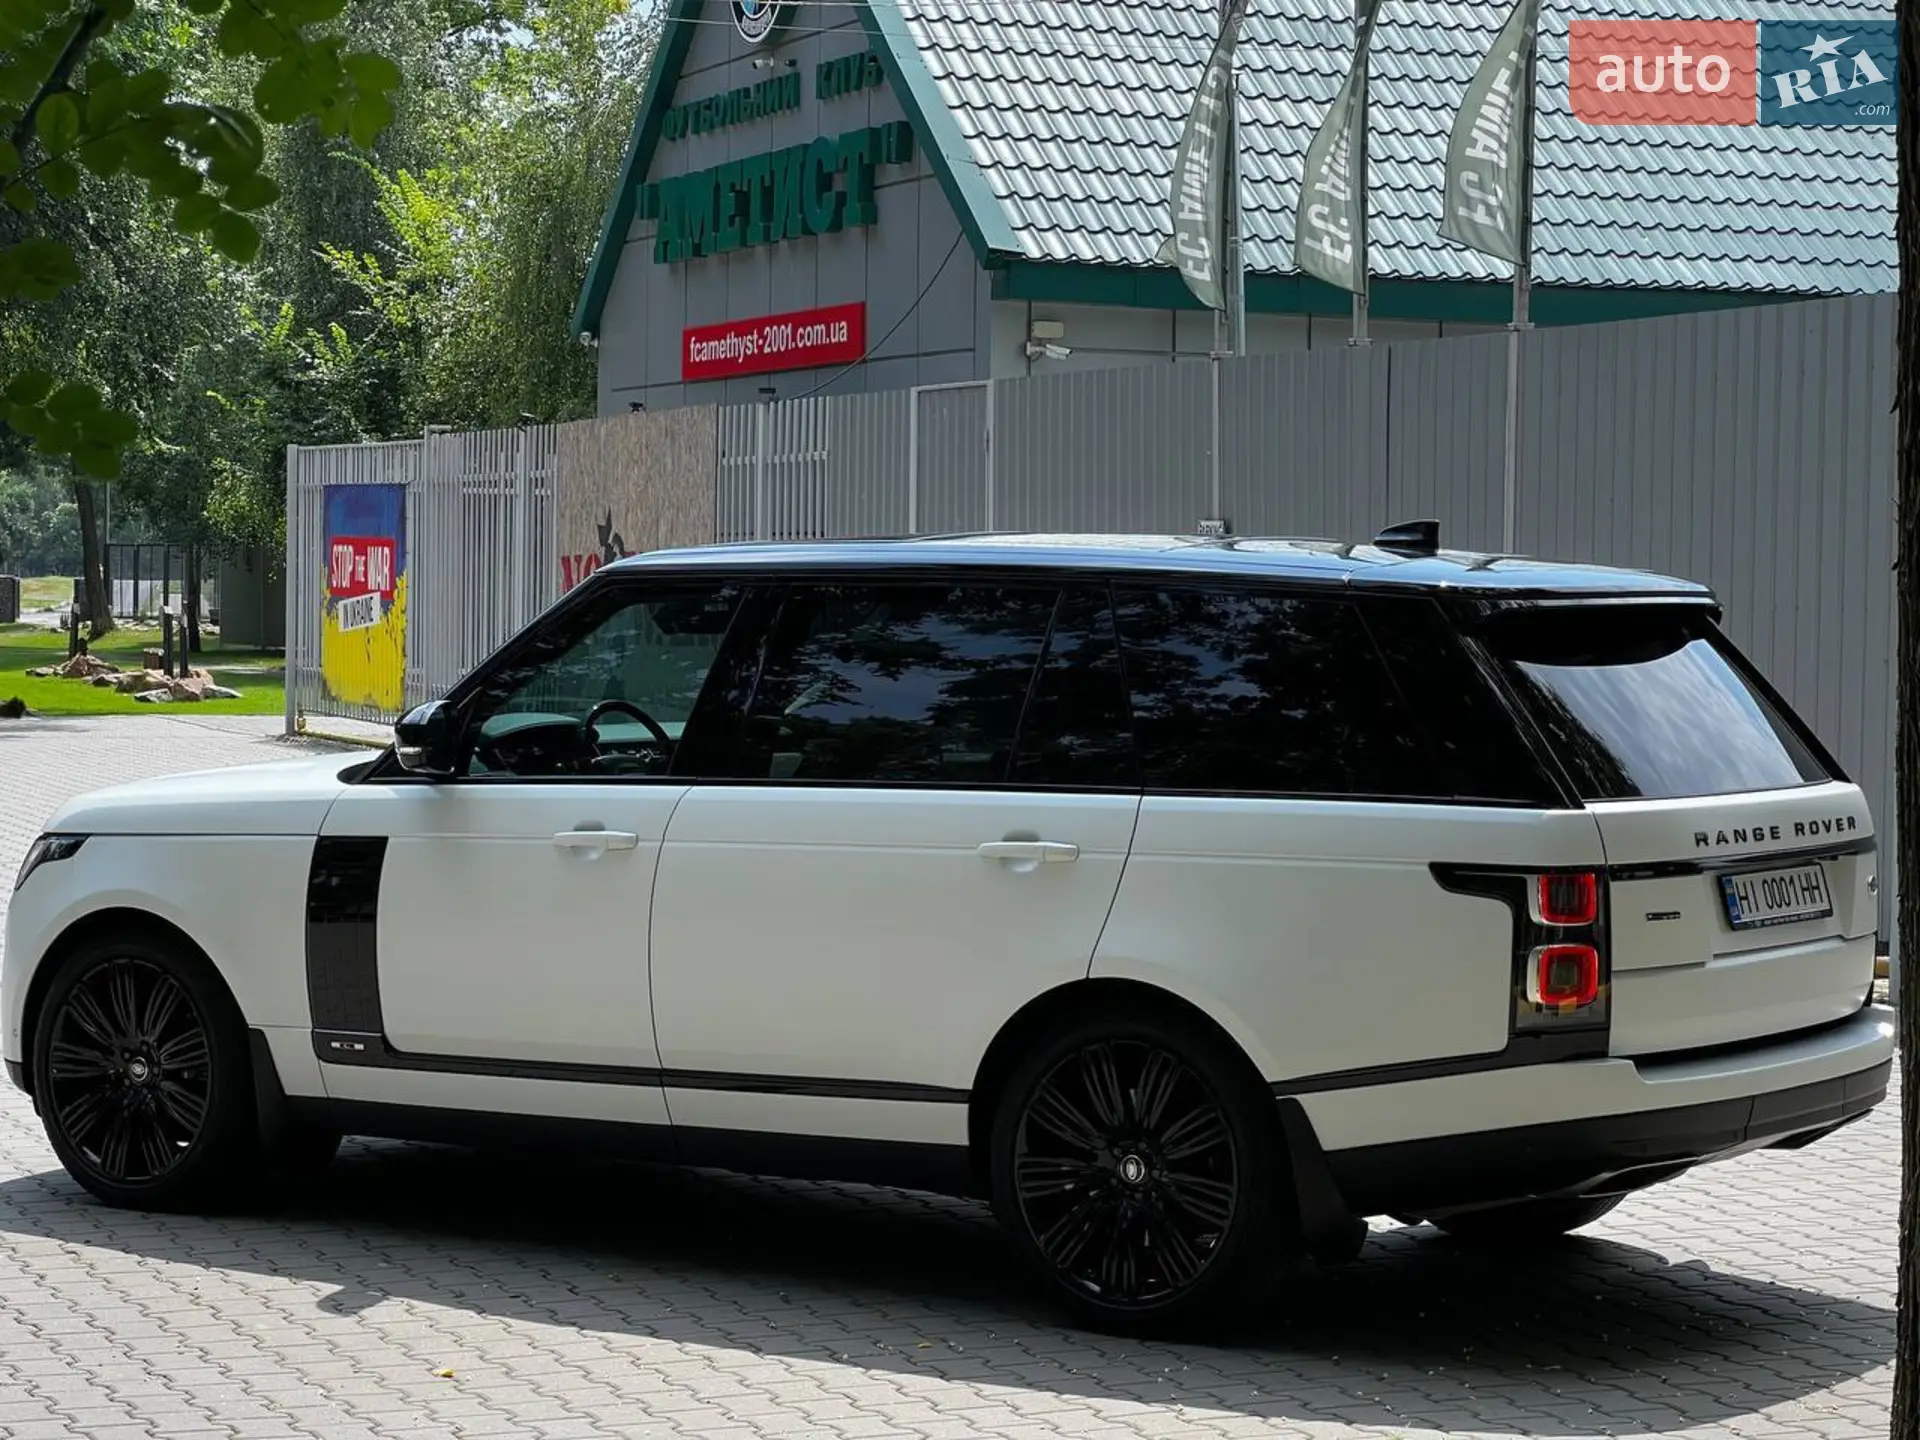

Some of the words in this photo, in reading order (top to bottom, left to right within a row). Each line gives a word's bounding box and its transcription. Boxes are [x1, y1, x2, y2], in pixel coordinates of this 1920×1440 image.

[816, 52, 884, 101] КЛУБ
[690, 310, 848, 363] fcamethyst-2001.com.ua
[332, 543, 354, 588] STOP
[355, 555, 366, 582] THE
[367, 545, 391, 591] WAR
[1694, 826, 1781, 848] RANGE
[1794, 815, 1857, 837] ROVER
[1762, 875, 1799, 910] 0001
[1798, 871, 1825, 906] HH
